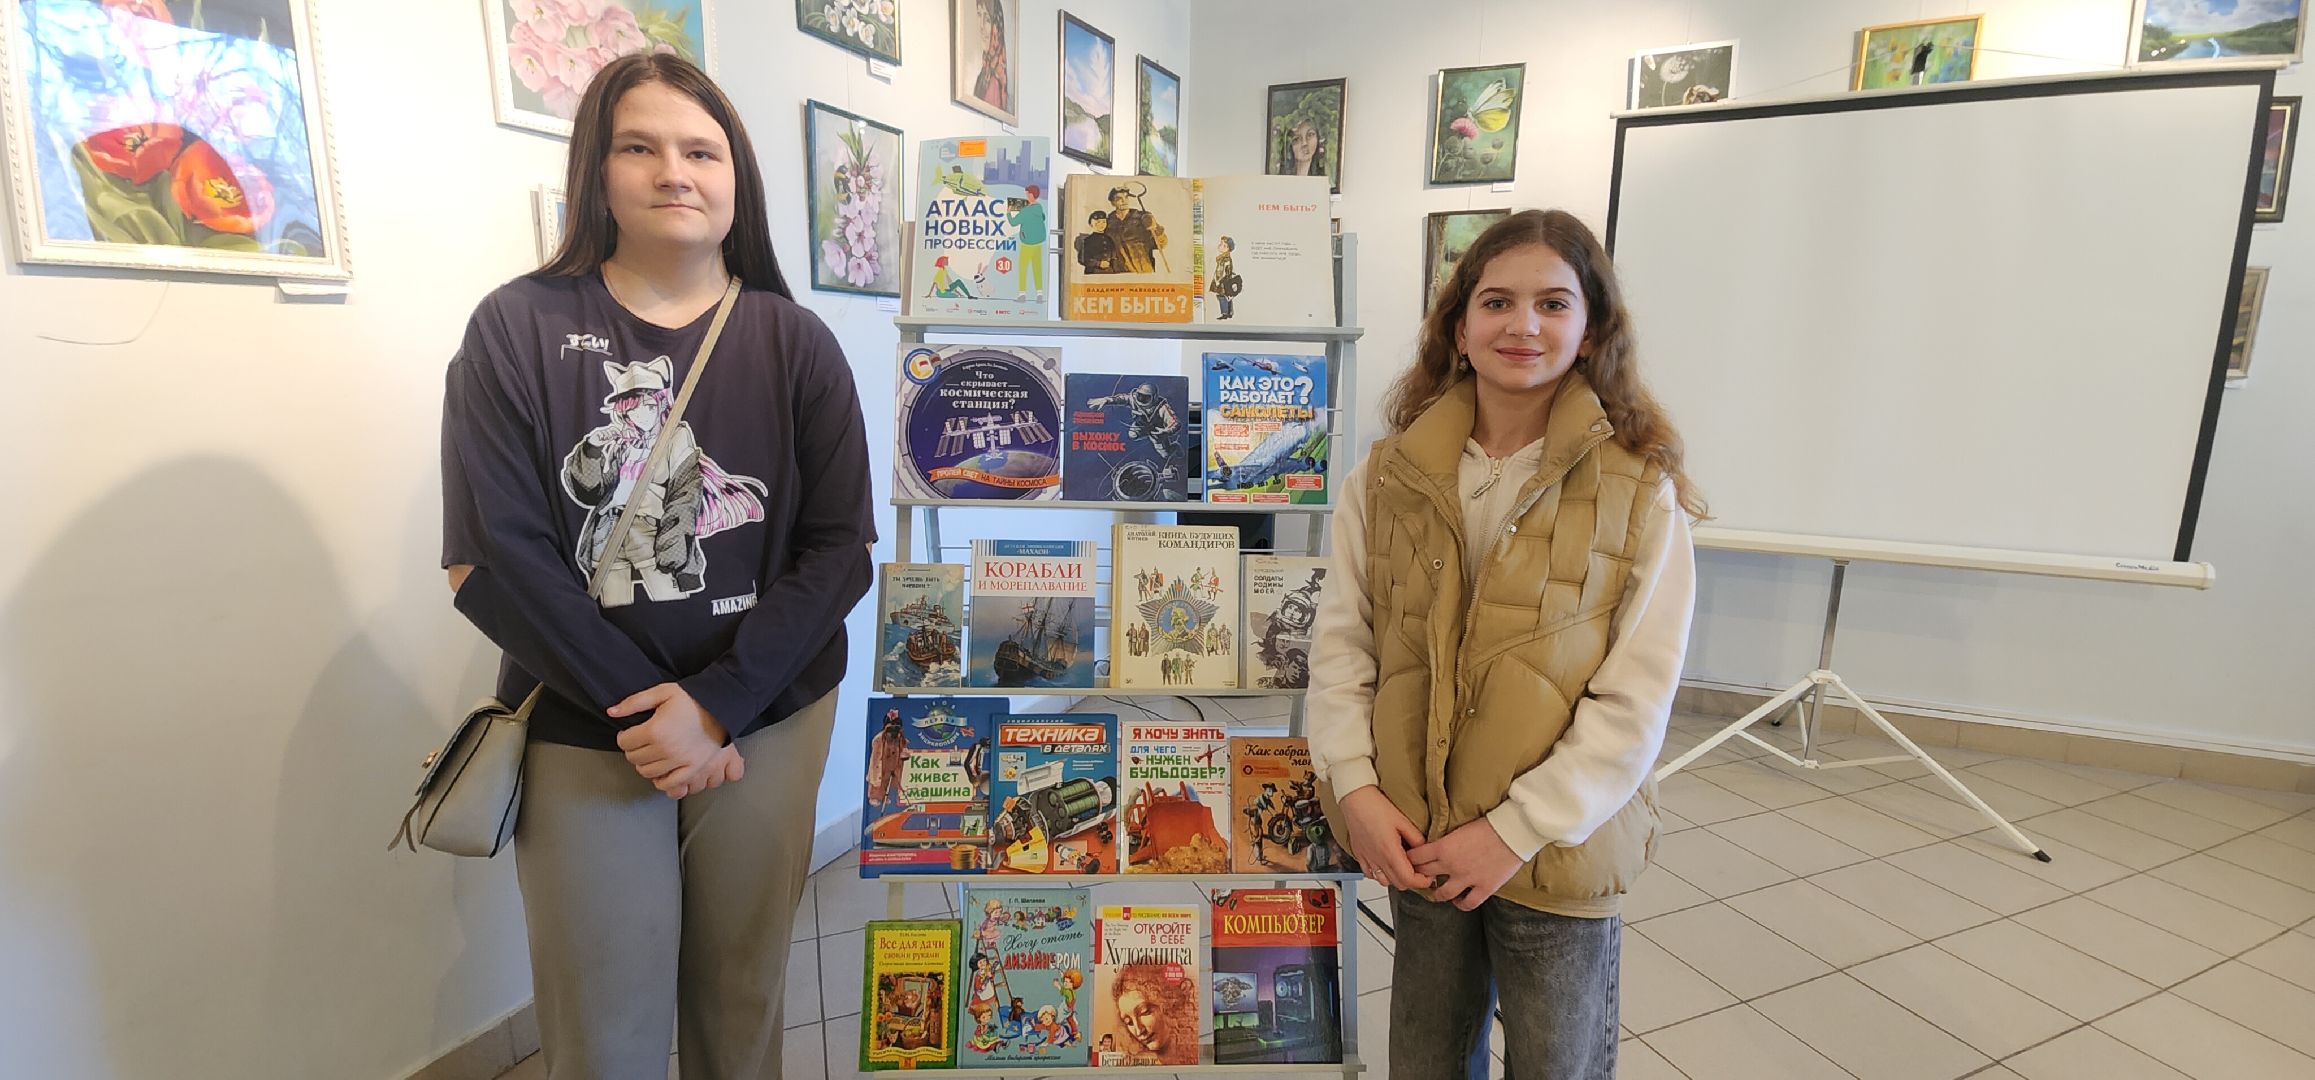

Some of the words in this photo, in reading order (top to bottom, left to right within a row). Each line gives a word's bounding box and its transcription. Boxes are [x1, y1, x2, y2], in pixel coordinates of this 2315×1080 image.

[925, 199, 1005, 218] АТЛАС
[1258, 203, 1280, 211] КЕМ
[1283, 203, 1317, 212] БЫТЬ?
[924, 219, 1006, 236] НОВЫХ
[924, 236, 1017, 251] ПРОФЕССИЙ
[1074, 296, 1113, 314] КЕМ
[1120, 294, 1187, 314] БЫТЬ?
[975, 370, 995, 379] Что
[960, 380, 1008, 388] скрывает
[1219, 376, 1256, 390] КАК
[1258, 377, 1295, 391] ЭТО
[940, 388, 1028, 398] космическая
[1220, 390, 1295, 404] РАБОТАЕТ
[952, 398, 1016, 410] станция?
[1072, 431, 1120, 441] ВЫХОЖУ
[1072, 440, 1080, 451] В
[1083, 441, 1126, 452] КОСМОС
[993, 476, 1015, 486] ТАЙНЫ
[1016, 478, 1047, 487] КОСМОСА
[1158, 531, 1188, 539] КНИГА
[1189, 532, 1235, 540] БУДУЩИХ
[1159, 540, 1235, 550] КОМАНДИРОВ
[985, 561, 1082, 578] КОРАБЛИ
[978, 580, 987, 590] И
[990, 581, 1088, 592] МОРЕПЛАВАНИЕ
[1132, 728, 1142, 739] Я
[1145, 728, 1179, 740] ХОЧУ
[1182, 728, 1225, 739] ЗНАТЬ
[1130, 745, 1150, 753] ДЛЯ
[1153, 745, 1177, 753] ЧЕГО
[1244, 744, 1271, 756] Как
[910, 755, 940, 768] Как
[1145, 755, 1191, 765] НУЖЕН
[909, 772, 959, 783] живет
[1129, 767, 1226, 779] БУЛЬДОЗЕР?
[908, 786, 971, 797] машина
[1134, 922, 1192, 934] ОТКРОЙТЕ
[1223, 914, 1326, 935] КОМПЬЮТЕР
[880, 937, 897, 949] Все
[899, 940, 918, 951] для
[920, 940, 945, 951] дачи
[1003, 934, 1038, 953] Хочу
[1041, 931, 1085, 945] стать
[1150, 935, 1157, 944] В
[1160, 935, 1185, 944] СЕБЕ
[912, 952, 940, 960] руками
[1004, 950, 1082, 971] ДИЗАЙНЕРОМ
[1104, 938, 1192, 974] Художника
